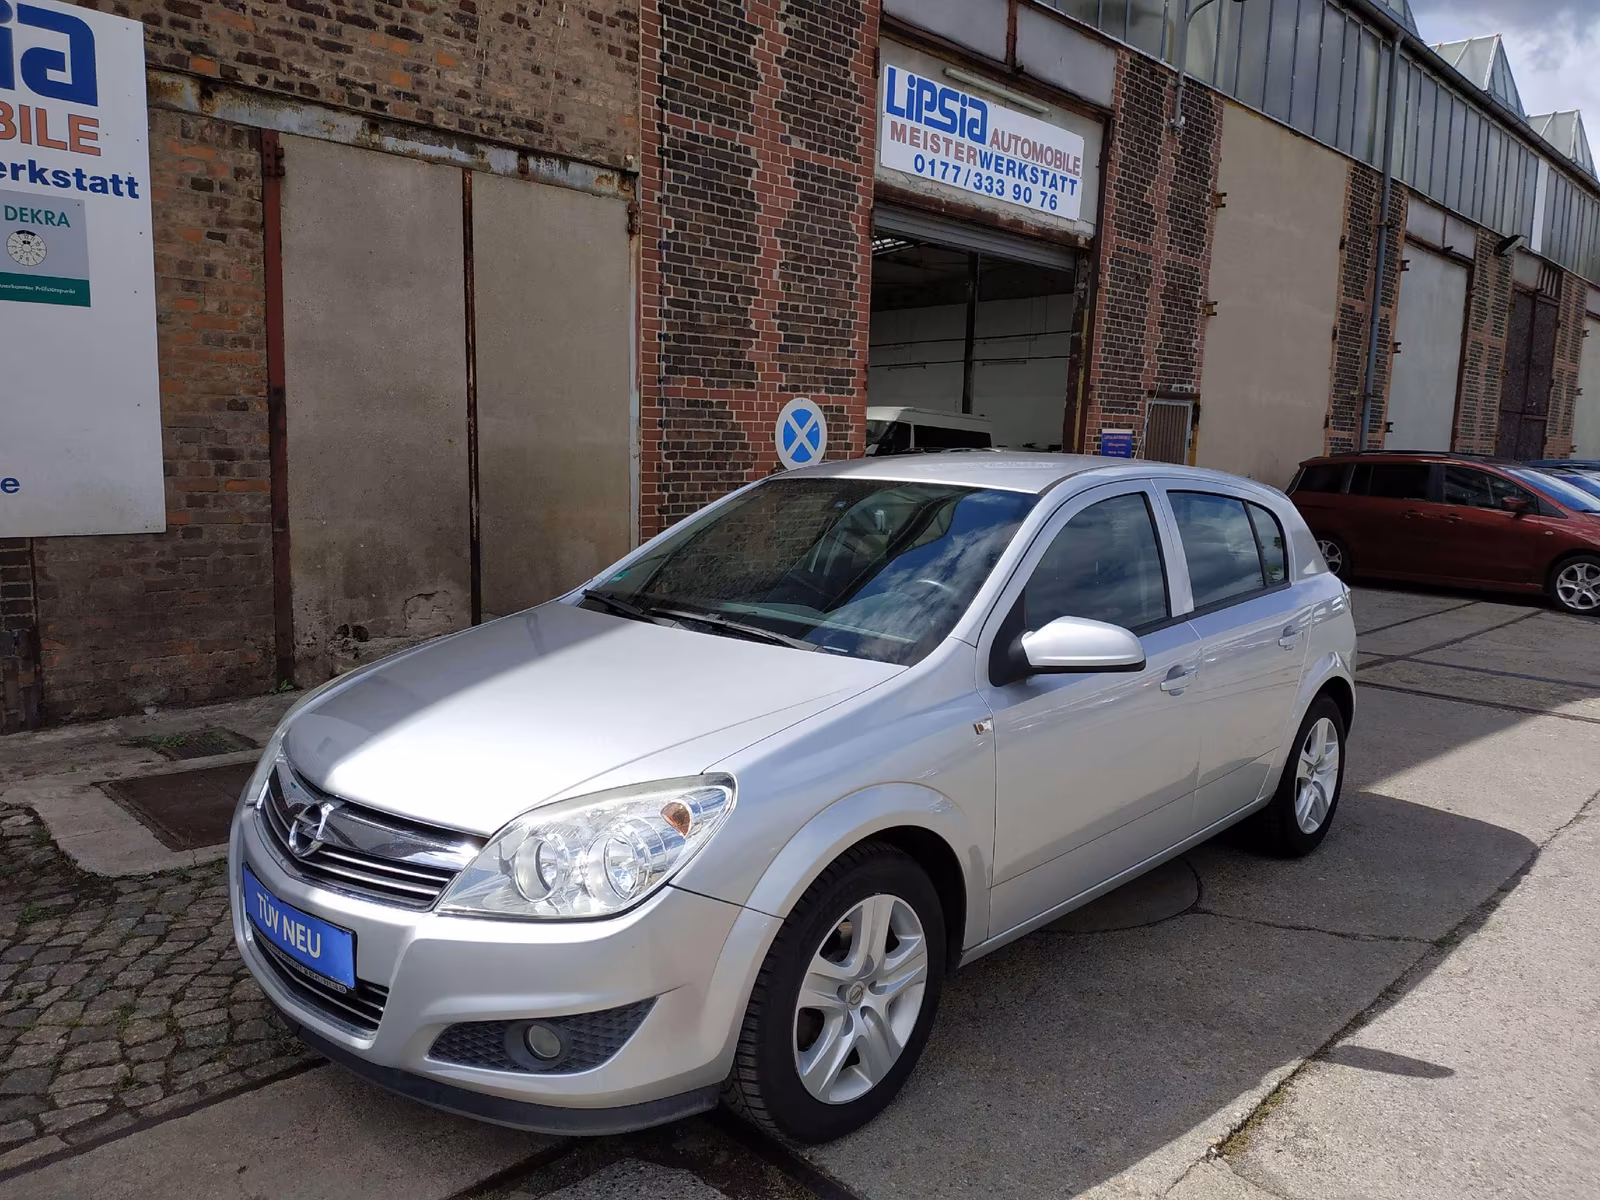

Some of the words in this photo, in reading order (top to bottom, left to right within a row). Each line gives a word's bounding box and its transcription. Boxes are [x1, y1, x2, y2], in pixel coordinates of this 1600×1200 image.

[890, 120, 1077, 196] MEISTERWERKSTATT
[990, 128, 1081, 177] AUTOMOBILE
[914, 154, 1005, 197] 0177/333
[1013, 184, 1032, 204] 90
[1040, 191, 1058, 211] 76
[4, 205, 71, 228] DEKRA
[0, 477, 20, 494] e
[257, 892, 279, 934] TÜV
[283, 914, 321, 958] NEU
